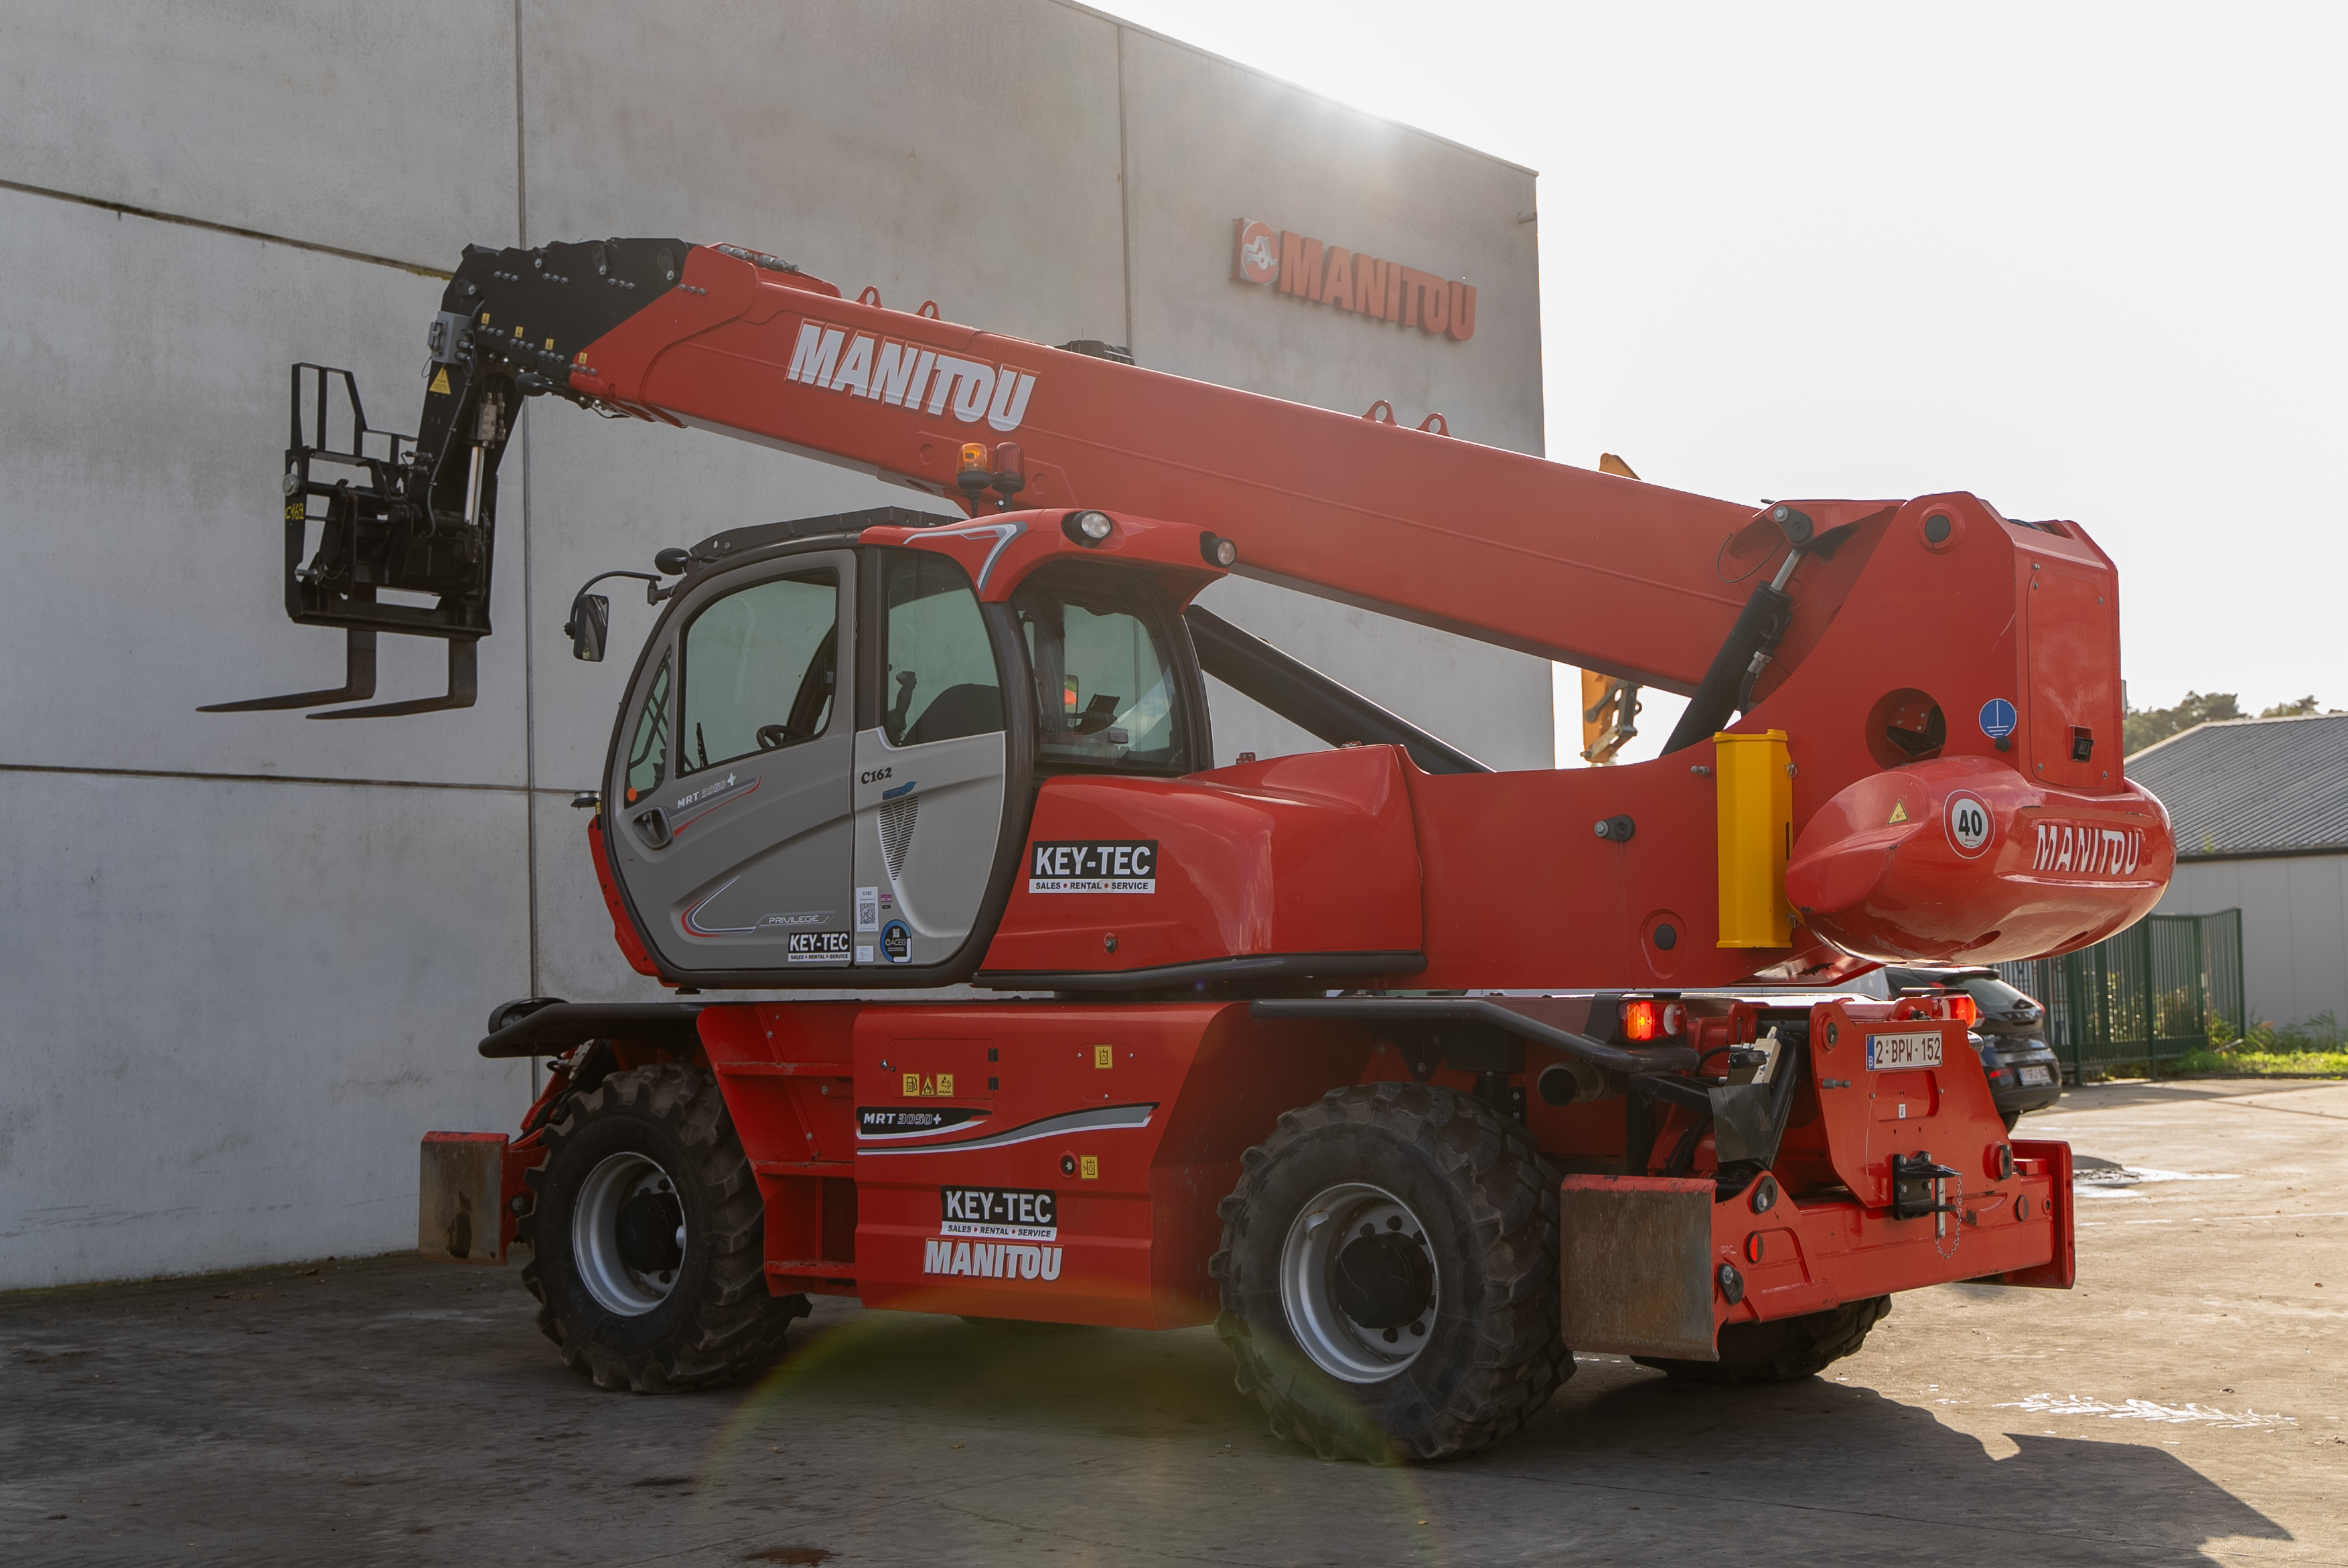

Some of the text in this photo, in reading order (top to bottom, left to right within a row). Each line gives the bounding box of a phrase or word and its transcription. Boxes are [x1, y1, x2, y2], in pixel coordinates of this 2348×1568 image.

[1277, 230, 1477, 341] MANITOU
[786, 323, 1037, 432] MANITOU
[861, 767, 892, 785] C162
[677, 791, 700, 808] MRT
[1958, 809, 1982, 837] 40
[2032, 824, 2140, 875] MANITOU
[1035, 846, 1151, 875] KEY-TEC
[1070, 882, 1102, 890] RENTAL
[1111, 882, 1149, 890] SERVICE
[768, 915, 819, 924] PRIVILEGE
[790, 933, 849, 951] KEY-TEC
[1868, 1056, 1873, 1067] B
[863, 1113, 942, 1125] MRT 3050+
[946, 1190, 1051, 1223] KEY-TEC
[948, 1225, 1051, 1237] SALES RENTAL SERVICE
[924, 1240, 1063, 1281] MANITOU
